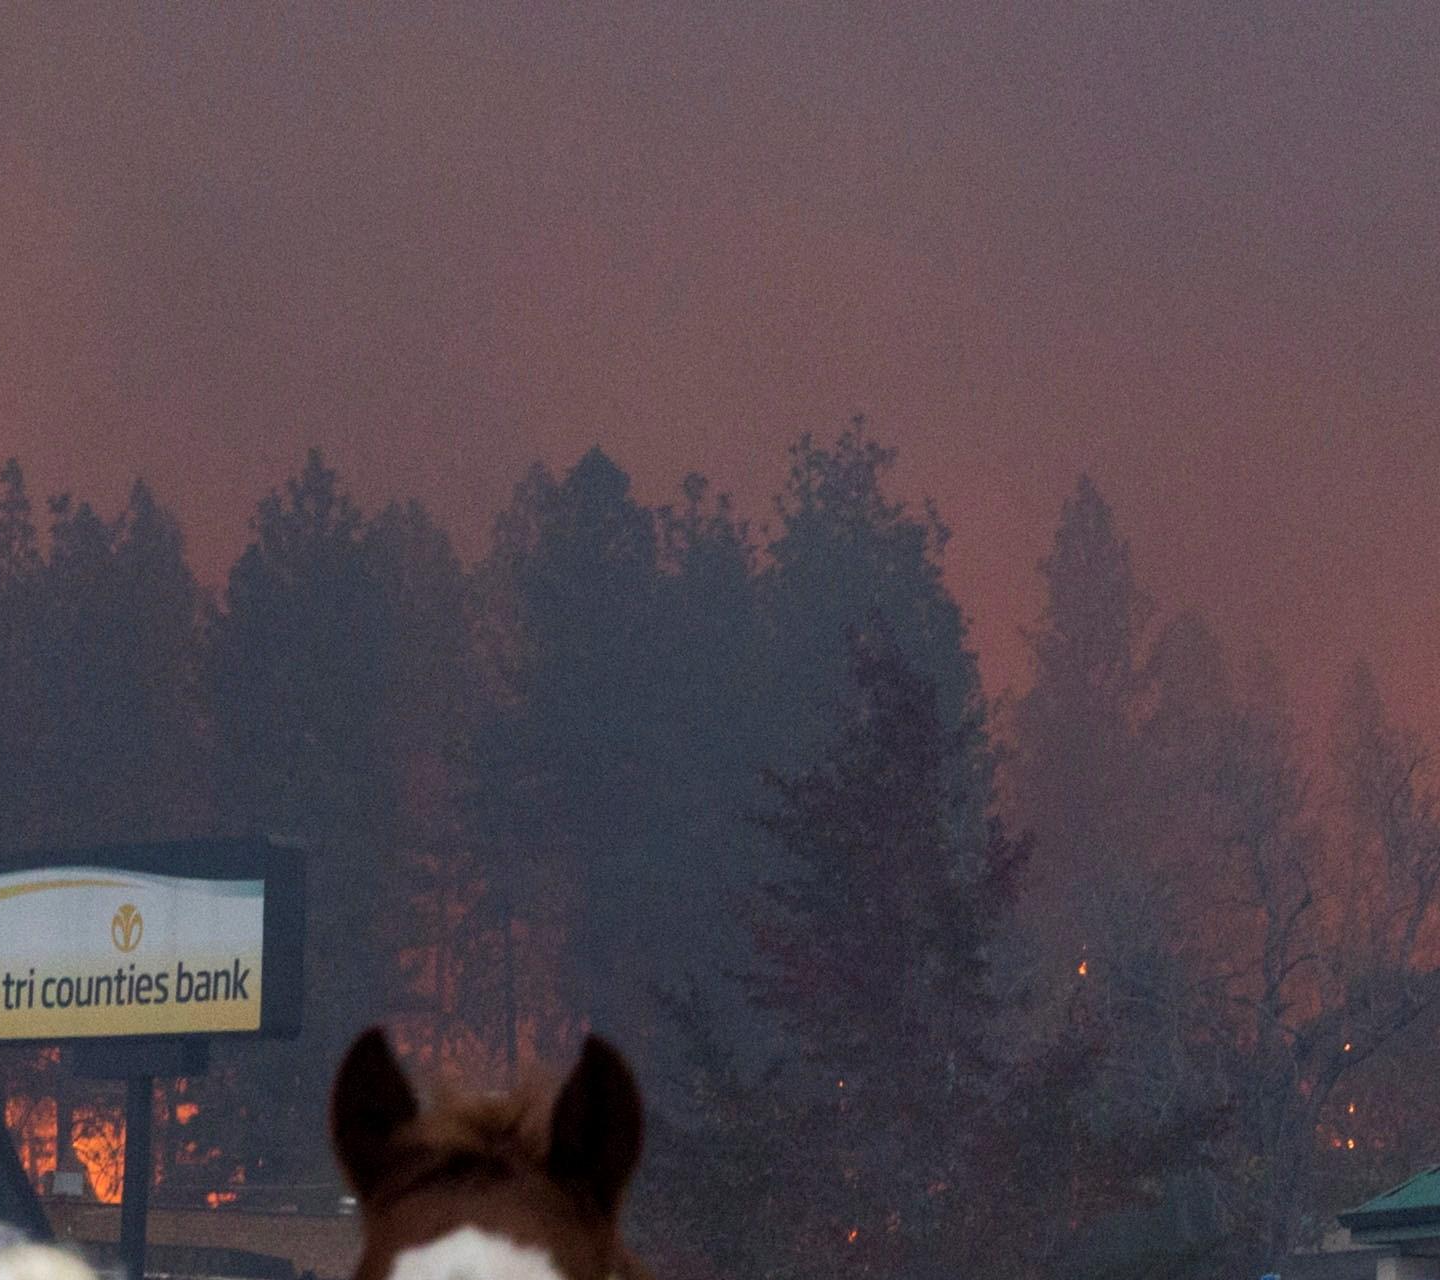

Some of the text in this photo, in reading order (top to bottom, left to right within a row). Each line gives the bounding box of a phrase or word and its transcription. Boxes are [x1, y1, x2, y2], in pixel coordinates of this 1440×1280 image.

[2, 958, 251, 1010] tri counties bank
